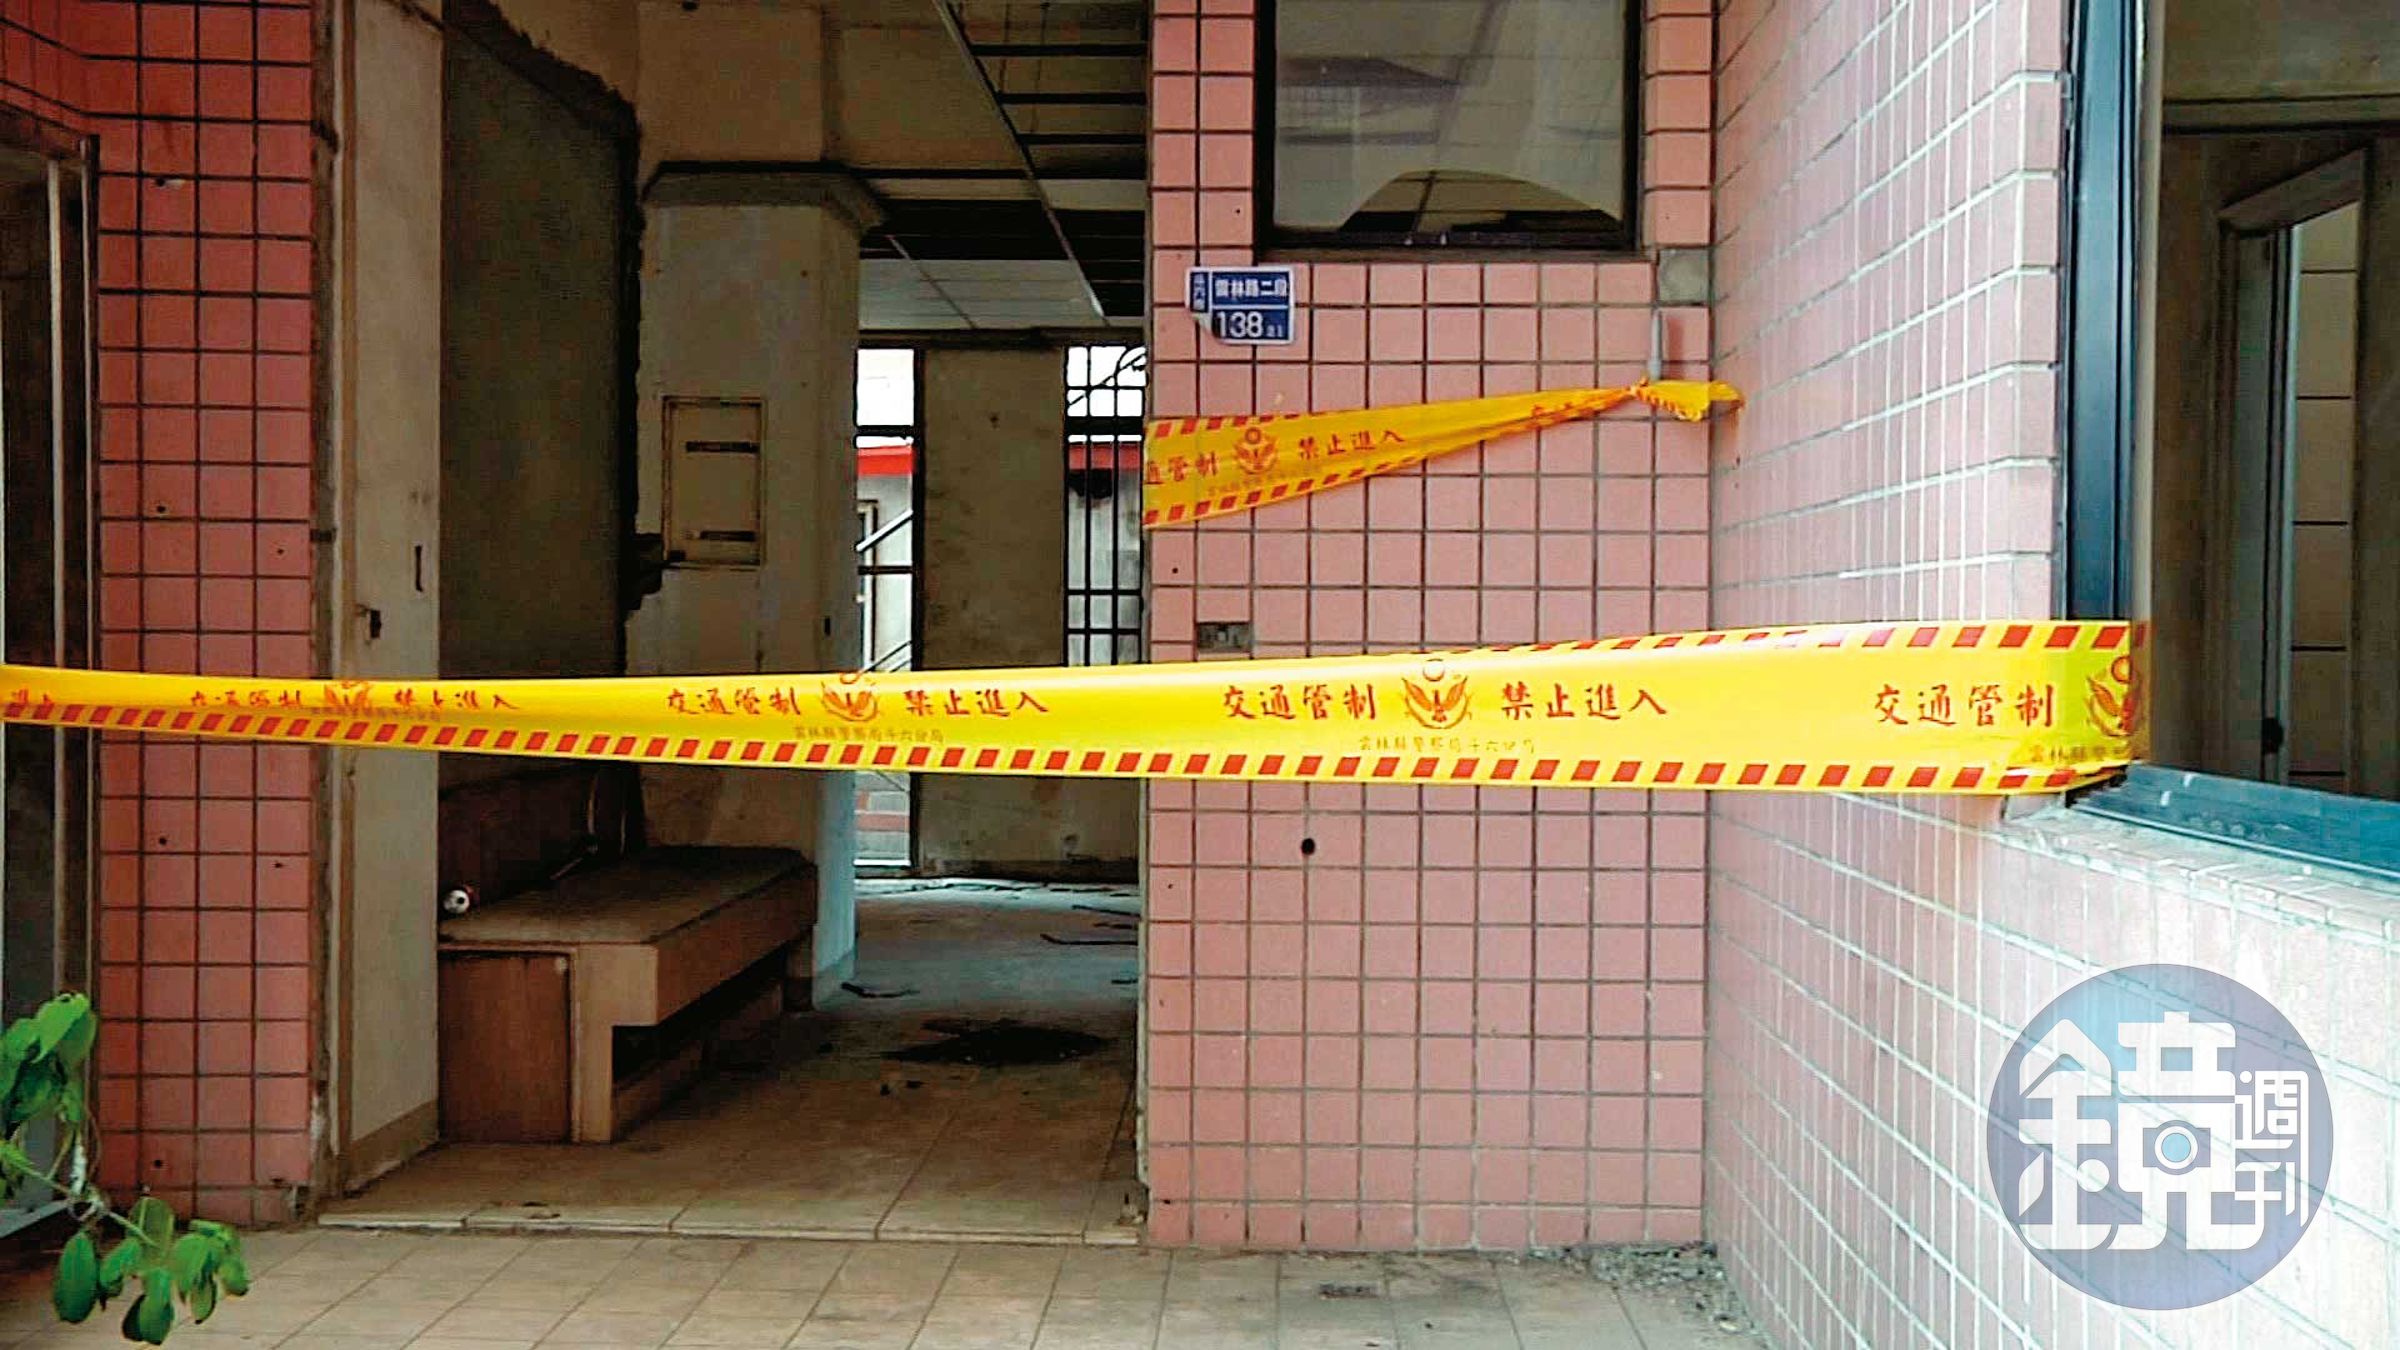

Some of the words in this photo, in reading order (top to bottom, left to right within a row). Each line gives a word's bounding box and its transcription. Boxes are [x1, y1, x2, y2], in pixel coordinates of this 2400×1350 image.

[1299, 430, 1405, 461] 禁止進入
[665, 686, 801, 716] 交通管制
[903, 688, 1050, 718] 禁止進入
[1223, 683, 1376, 721] 交通管制
[1499, 681, 1668, 721] 禁止進入
[1875, 683, 2055, 728] 交通管制
